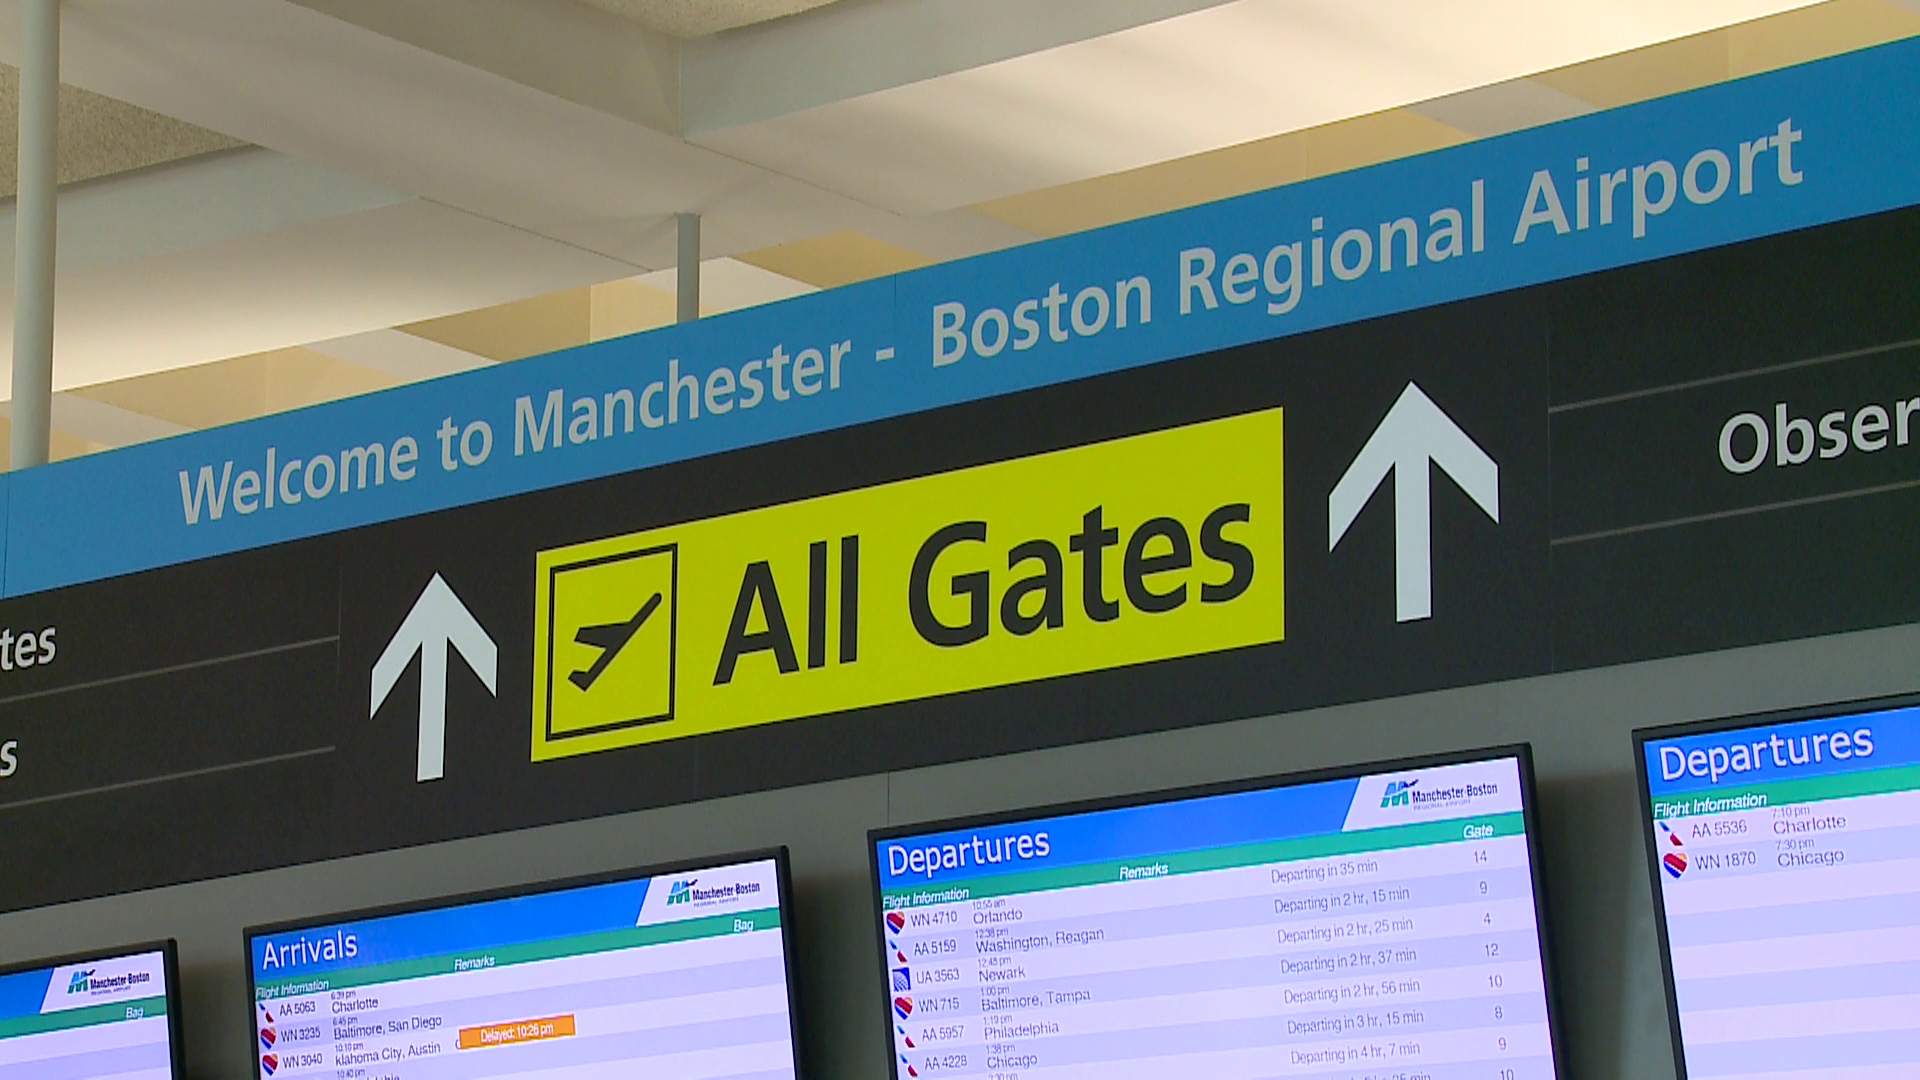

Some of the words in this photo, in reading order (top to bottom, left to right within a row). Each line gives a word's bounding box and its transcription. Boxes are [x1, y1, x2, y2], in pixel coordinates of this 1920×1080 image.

[179, 436, 419, 526] Welcome
[437, 416, 493, 472] to
[514, 339, 852, 457] Manchester
[932, 273, 1153, 368] Boston
[1178, 180, 1486, 316] Regional
[1513, 117, 1804, 241] Airport
[1718, 396, 1920, 474] Obser
[712, 534, 860, 687] All
[908, 502, 1255, 648] Gates
[1659, 728, 1874, 783] Departures
[1654, 800, 1690, 819] Flight
[1693, 793, 1768, 814] Information
[1794, 806, 1811, 819] pm
[1463, 824, 1494, 839] Gate
[1692, 821, 1711, 838] AA
[1714, 820, 1747, 836] 5536
[1773, 815, 1847, 835] Charlotte
[1798, 839, 1815, 851] pm
[888, 831, 1051, 878] Departures
[1473, 850, 1488, 864] 14
[1695, 855, 1720, 871] WN
[1724, 851, 1756, 868] 1870
[1777, 850, 1844, 869] Chicago
[1119, 863, 1169, 880] Remarks
[1271, 864, 1325, 884] Departing
[1327, 862, 1338, 877] in
[1340, 861, 1355, 875] 35
[1356, 859, 1378, 874] min
[1479, 881, 1488, 895] 9
[882, 891, 910, 909] Flight
[913, 887, 970, 905] Information
[1274, 893, 1328, 914] Departing
[1331, 892, 1341, 906] in
[1343, 891, 1351, 906] 2
[1373, 888, 1387, 902] 15
[1388, 886, 1410, 901] min
[910, 912, 930, 928] WN
[932, 911, 958, 925] 4710
[973, 908, 1023, 924] Orlando
[1483, 911, 1491, 925] 4
[733, 919, 754, 933] Bag
[996, 927, 1009, 938] pm
[1277, 924, 1332, 945] Departing
[1334, 923, 1344, 937] in
[1346, 921, 1354, 936] 2
[1374, 919, 1390, 933] 25
[1392, 917, 1413, 931] min
[914, 942, 930, 956] AA
[931, 939, 957, 954] 5159
[975, 934, 1053, 955] Washington,
[1056, 928, 1105, 946] Reagan
[1484, 943, 1499, 957] 12
[262, 930, 358, 971] Arrivals
[454, 955, 495, 971] Remarks
[999, 957, 1012, 967] pm
[1281, 954, 1335, 975] Departing
[1337, 953, 1348, 967] in
[1350, 952, 1358, 966] 2
[1378, 949, 1393, 964] 37
[1395, 947, 1417, 962] min
[916, 970, 933, 984] UA
[934, 968, 960, 982] 3563
[979, 965, 1026, 982] Newark
[1488, 974, 1503, 988] 10
[255, 986, 279, 1000] Flight
[281, 980, 329, 995] Information
[345, 990, 356, 1000] pm
[997, 985, 1010, 997] pm
[1284, 985, 1338, 1005] Departing
[1340, 984, 1351, 998] in
[1353, 982, 1361, 997] 2
[1381, 980, 1397, 994] 56
[1399, 978, 1420, 993] min
[279, 1003, 292, 1016] AA
[294, 1001, 316, 1014] 5063
[332, 998, 378, 1014] Charlotte
[919, 999, 938, 1013] WN
[940, 996, 960, 1011] 715
[982, 995, 1043, 1012] Baltimore,
[1046, 989, 1091, 1005] Tampa
[126, 1007, 144, 1018] Bag
[347, 1016, 358, 1026] pm
[1000, 1015, 1013, 1025] pm
[1494, 1005, 1503, 1020] 8
[333, 1024, 386, 1041] Baltimore,
[388, 1020, 409, 1032] San
[411, 1016, 442, 1031] Diego
[1287, 1015, 1342, 1035] Departing
[1344, 1014, 1354, 1029] in
[1356, 1013, 1365, 1028] 3
[1386, 1011, 1400, 1025] 15
[1402, 1008, 1424, 1023] min
[281, 1030, 298, 1042] WN
[299, 1026, 321, 1040] 3235
[481, 1027, 515, 1043] Delayed:
[540, 1023, 554, 1036] pm
[922, 1027, 938, 1042] AA
[939, 1025, 965, 1040] 5957
[984, 1021, 1060, 1041] Philadelphia
[353, 1042, 364, 1052] pm
[382, 1047, 405, 1061] City,
[408, 1041, 441, 1057] Austin
[1003, 1043, 1016, 1054] pm
[1498, 1036, 1507, 1051] 9
[283, 1056, 299, 1069] WN
[301, 1053, 323, 1066] 3040
[1291, 1045, 1345, 1066] Departing
[1347, 1045, 1358, 1060] in
[1360, 1044, 1368, 1058] 4
[1388, 1042, 1396, 1056] 7
[1399, 1040, 1420, 1055] min
[924, 1056, 940, 1071] AA
[942, 1055, 968, 1069] 4228
[987, 1055, 1038, 1069] Chicago
